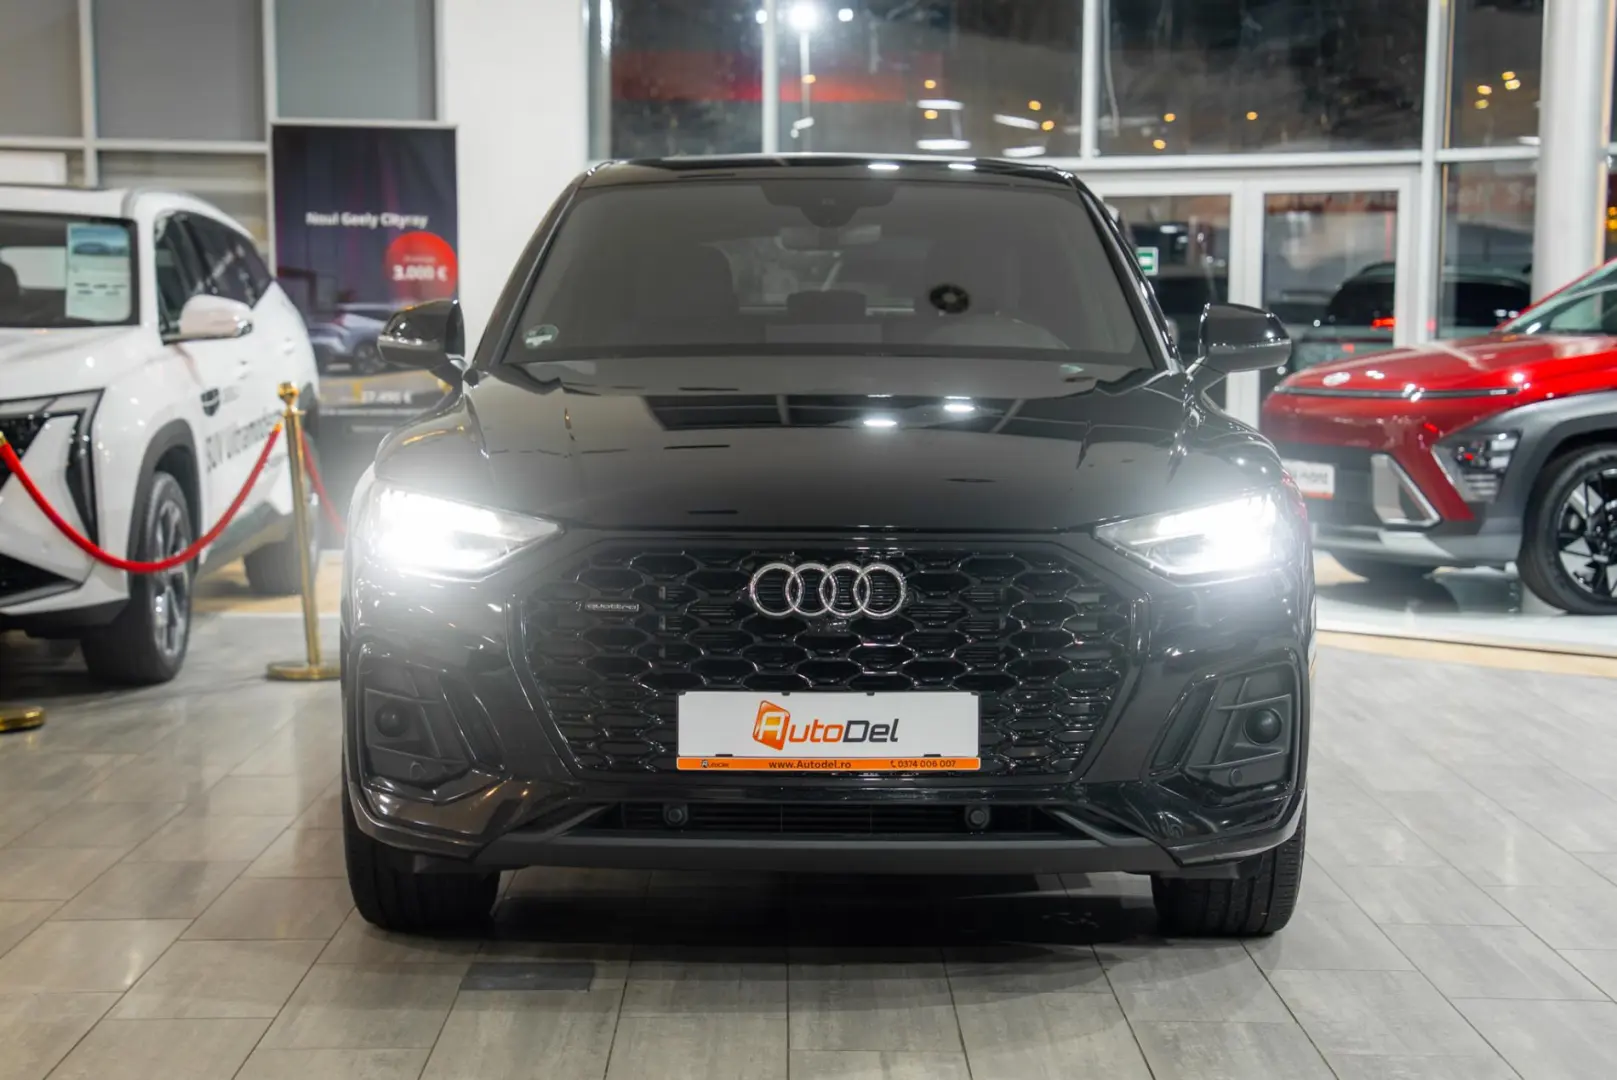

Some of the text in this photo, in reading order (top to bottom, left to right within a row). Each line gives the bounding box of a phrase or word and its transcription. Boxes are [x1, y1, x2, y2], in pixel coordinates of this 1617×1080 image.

[305, 212, 428, 229] Noul Geely Cityray
[586, 603, 637, 611] quattro
[754, 702, 899, 749] AutoDel
[768, 760, 851, 769] www.Autodel.ro
[897, 760, 956, 768] 0374 006 007
